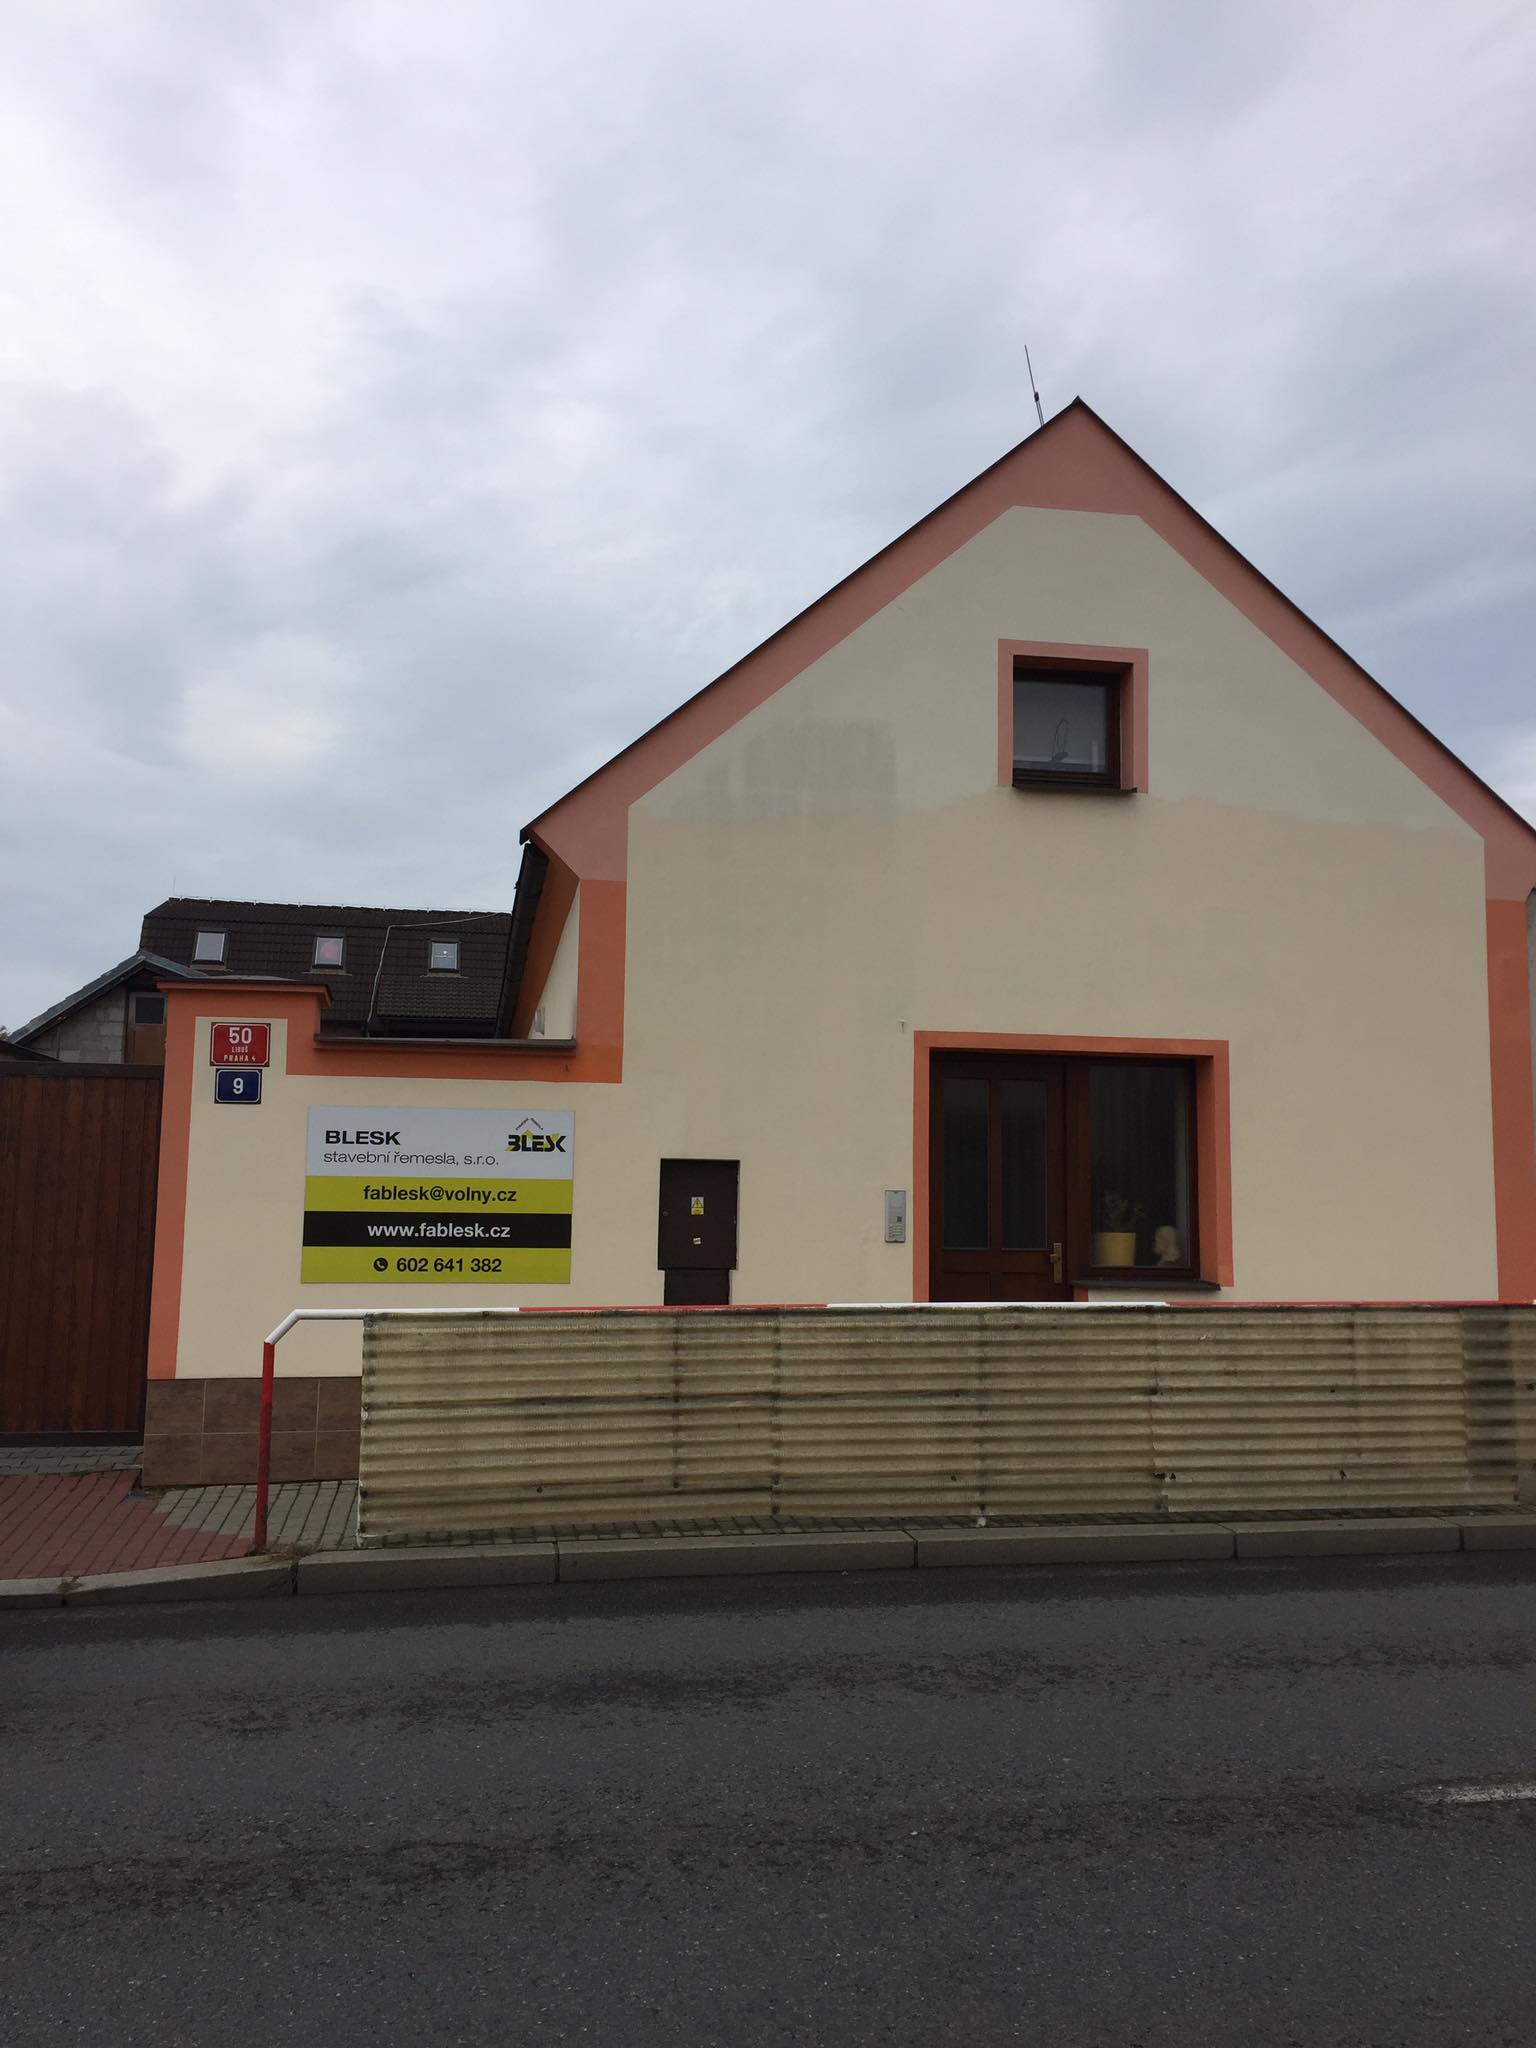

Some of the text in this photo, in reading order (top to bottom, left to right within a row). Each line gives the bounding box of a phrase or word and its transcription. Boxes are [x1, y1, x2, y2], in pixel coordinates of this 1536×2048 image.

[229, 1027, 252, 1044] 50
[223, 1054, 249, 1062] PRAHA
[232, 1077, 244, 1095] 9
[325, 1130, 401, 1146] BLESK
[506, 1134, 567, 1153] BLESK
[323, 1151, 499, 1166] stavební řemesla, s.r.o.
[363, 1185, 517, 1204] fablesk@volny.cz
[367, 1222, 511, 1238] www.fablesk.cz
[396, 1257, 503, 1273] 602 641 382
